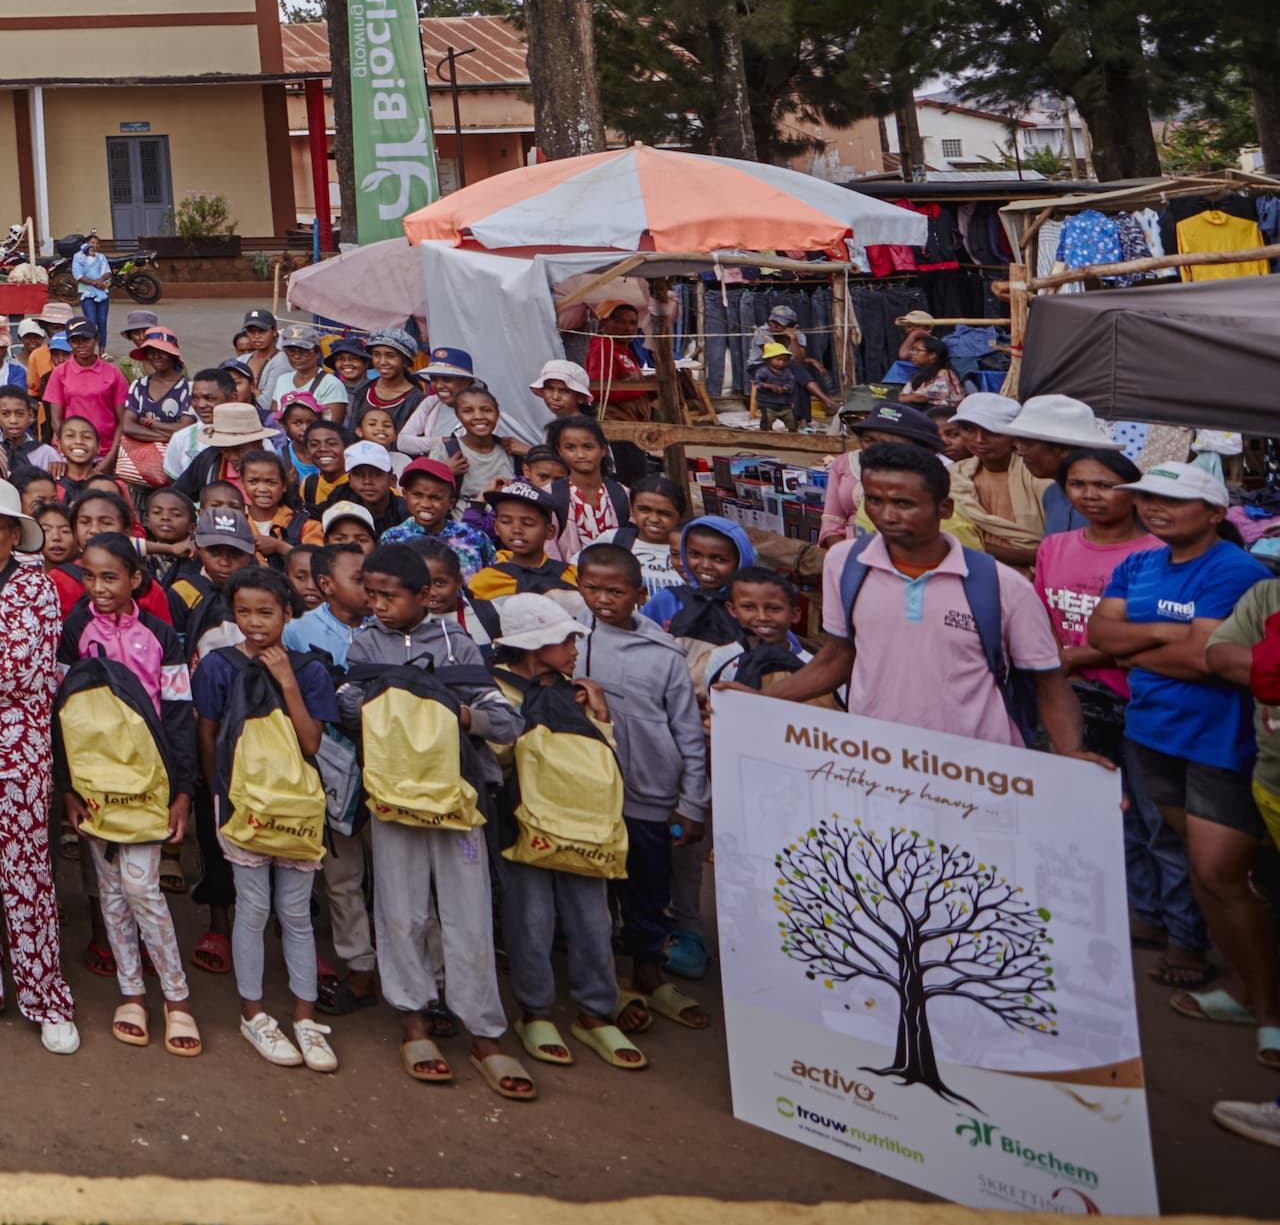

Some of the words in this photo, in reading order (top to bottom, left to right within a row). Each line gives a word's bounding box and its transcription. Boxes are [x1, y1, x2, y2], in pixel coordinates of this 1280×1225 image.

[784, 723, 891, 764] Mikolo
[901, 748, 1035, 796] kilonga
[806, 760, 880, 797] Antoky
[791, 1059, 876, 1102] activo
[796, 1105, 847, 1134] trouw
[850, 1126, 925, 1164] nutrition
[1000, 1135, 1099, 1185] Biochem
